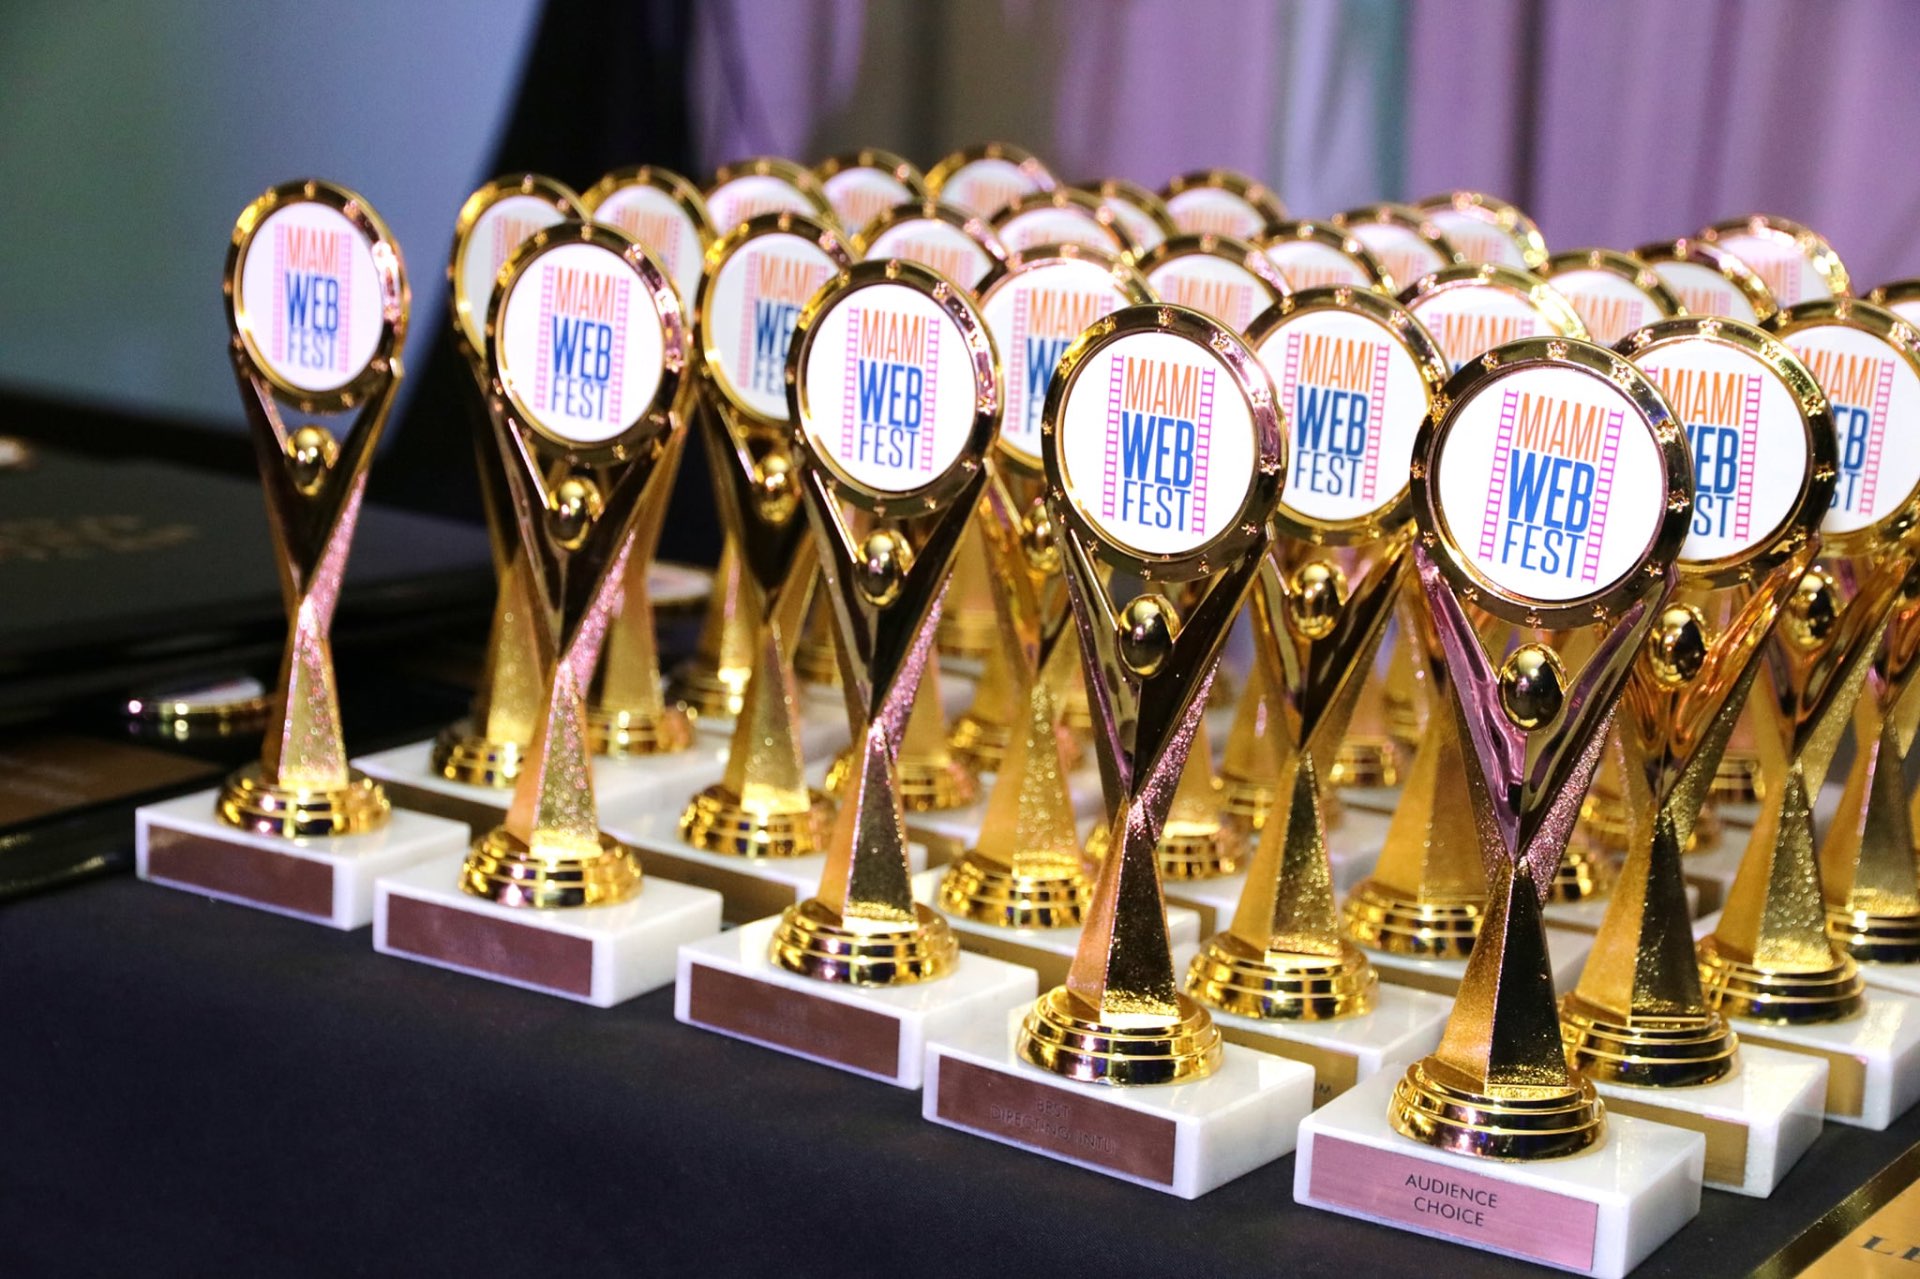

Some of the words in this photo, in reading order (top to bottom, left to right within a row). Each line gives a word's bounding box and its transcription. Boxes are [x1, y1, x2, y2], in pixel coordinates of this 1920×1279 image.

[286, 225, 340, 275] MIAMI
[285, 270, 339, 332] WEB
[554, 267, 616, 321] MIAMI
[287, 327, 336, 370] FEST
[552, 315, 612, 381] WEB
[755, 300, 797, 359] WE
[861, 308, 926, 365] MIAMI
[1125, 357, 1199, 420] MIAMI
[1300, 334, 1374, 393] MIAMI
[551, 375, 608, 421] FEST
[859, 360, 923, 429] WEB
[1297, 385, 1369, 456] WEB
[859, 424, 920, 470] FEST
[1122, 411, 1195, 488] WEB
[1516, 393, 1605, 462] MIAMI
[1295, 450, 1362, 498] FEST
[1687, 424, 1739, 494] EB
[1122, 480, 1191, 531] FEST
[1508, 449, 1595, 533] WEB
[1693, 493, 1734, 538] ST
[1502, 520, 1585, 578] FEST
[1405, 1174, 1498, 1208] AUDIENCE
[1414, 1196, 1484, 1227] CHOICE
